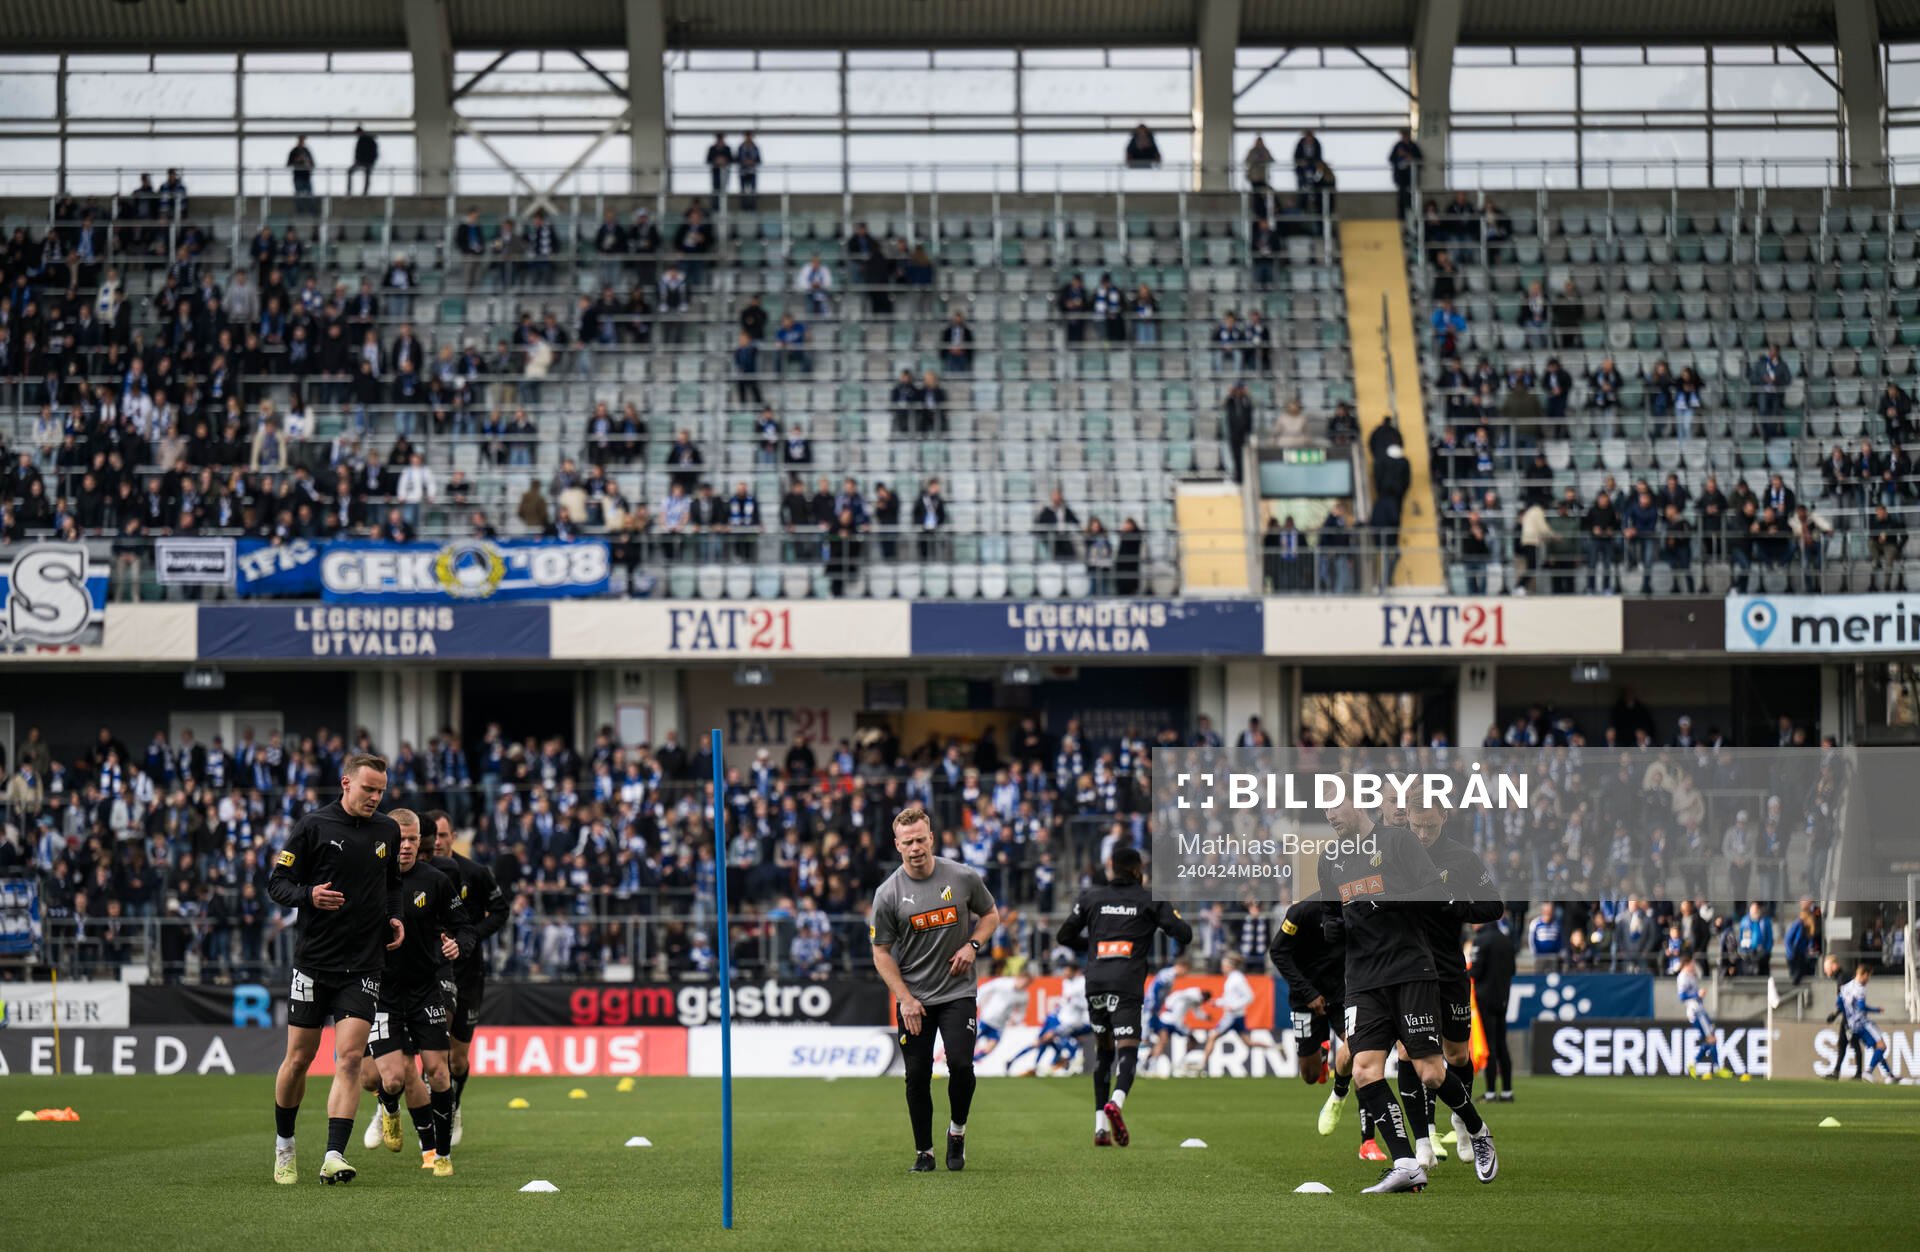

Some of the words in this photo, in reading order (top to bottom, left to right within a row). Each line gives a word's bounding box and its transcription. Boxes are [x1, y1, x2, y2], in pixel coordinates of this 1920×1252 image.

[295, 606, 454, 632] LEGENDENS
[1008, 604, 1167, 628] LEGENDENS
[1380, 603, 1506, 647] FAT21
[668, 607, 793, 650] FAT21
[1025, 628, 1150, 652] UTVALDA
[311, 632, 436, 656] UTVALDA
[1340, 879, 1381, 898] BRA
[915, 911, 956, 927] BRA
[1100, 905, 1137, 915] stadium
[1405, 1013, 1433, 1027] Varis
[0, 1036, 236, 1076] ELEDA
[790, 1045, 881, 1066] SUPER
[1551, 1026, 1769, 1076] SERNEKE
[1388, 1102, 1407, 1138] MAXXIS
